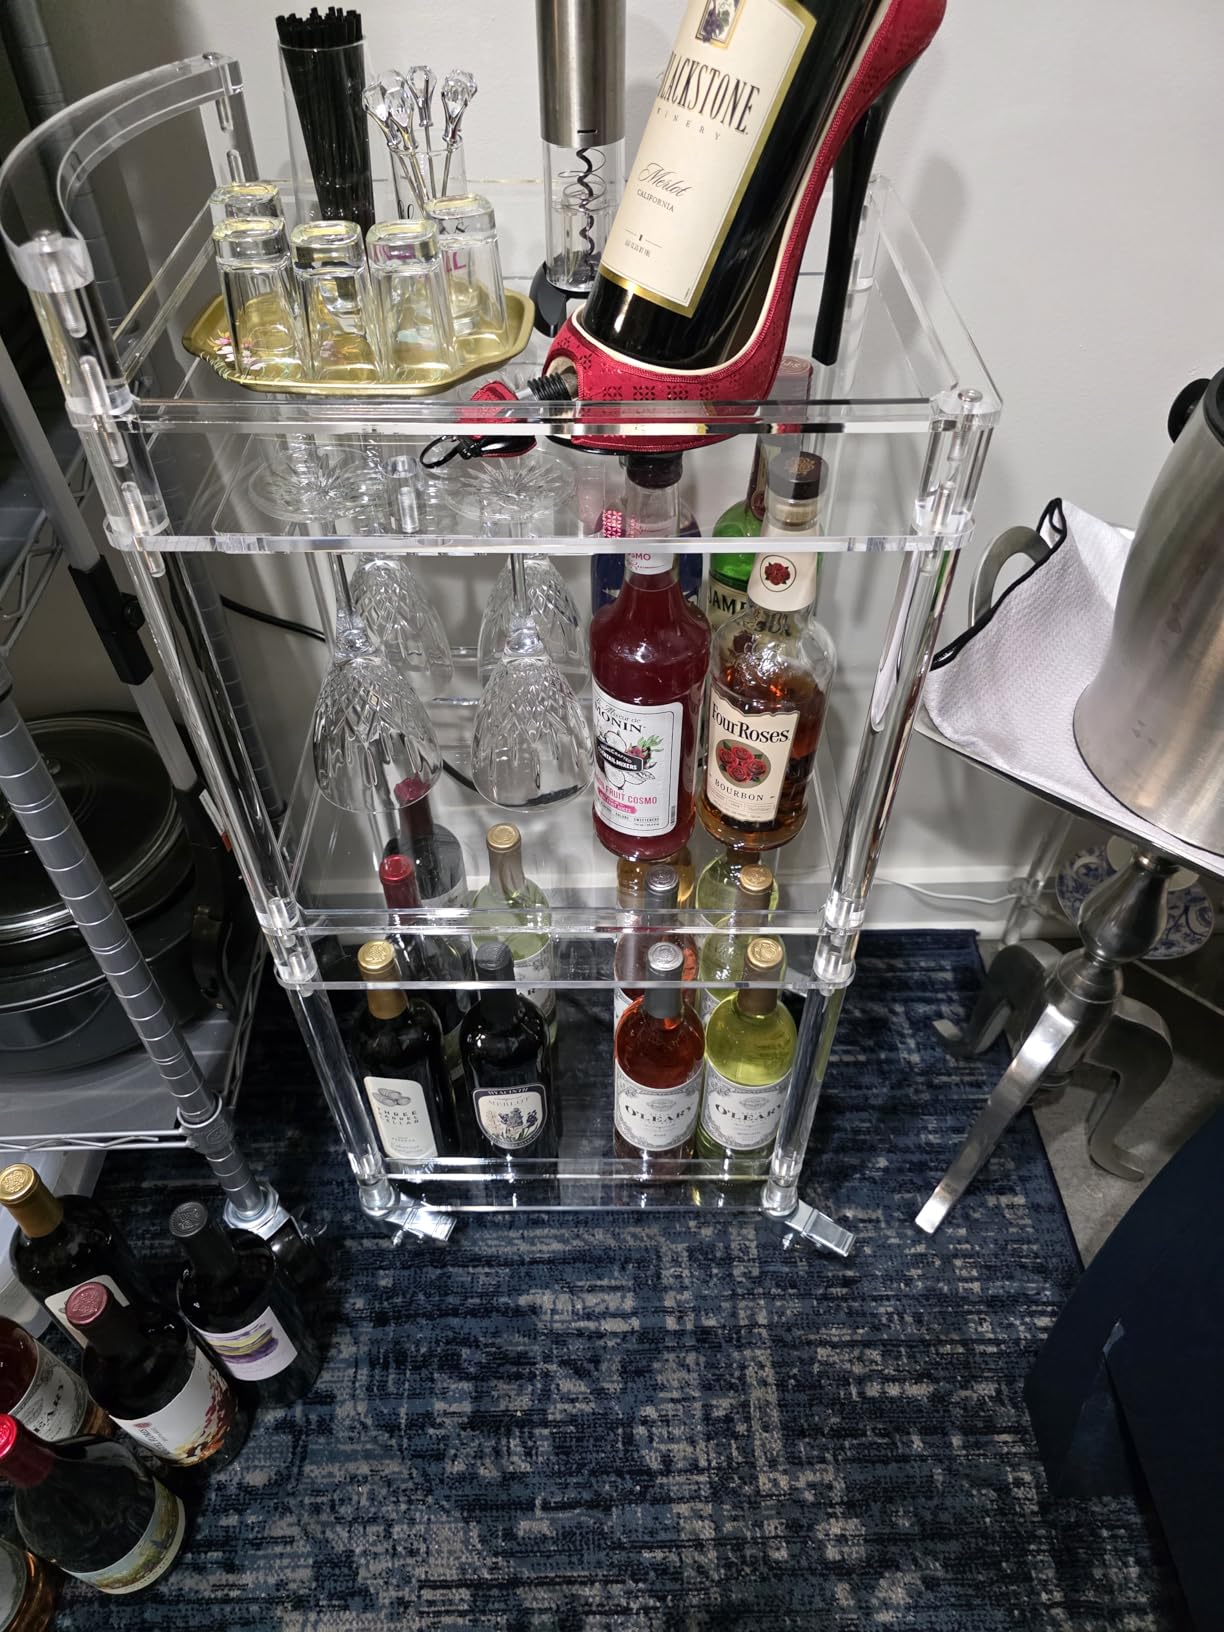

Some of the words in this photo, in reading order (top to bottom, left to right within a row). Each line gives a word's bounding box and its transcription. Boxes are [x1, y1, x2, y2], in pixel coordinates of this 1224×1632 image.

[657, 50, 760, 135] LACKSTONE
[639, 162, 693, 198] Merlot
[637, 188, 675, 213] CALIFORNIA
[712, 703, 738, 735] Four
[737, 720, 790, 744] Roses
[605, 785, 626, 802] FRUIT
[627, 795, 658, 805] COSMO
[714, 778, 764, 801] BOURBON
